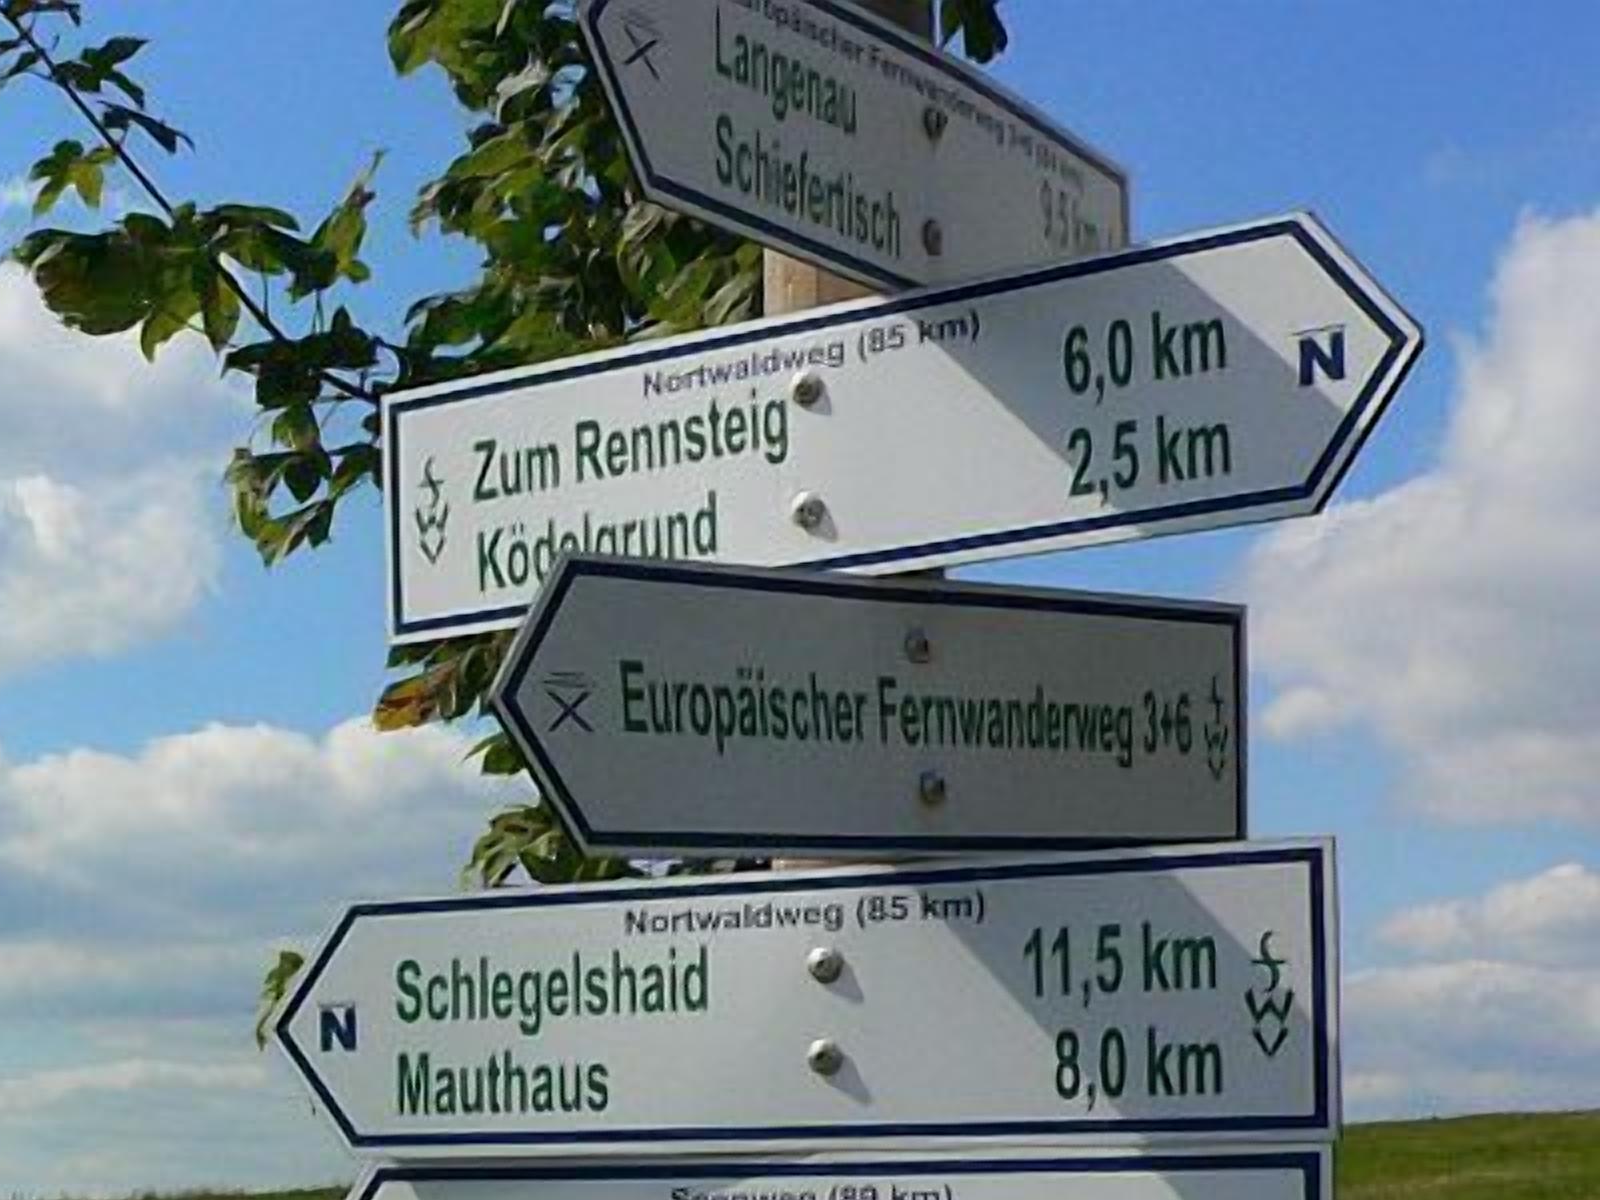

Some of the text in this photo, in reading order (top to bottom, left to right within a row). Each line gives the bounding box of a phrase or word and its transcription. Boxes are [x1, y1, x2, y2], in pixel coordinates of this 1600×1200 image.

[715, 4, 857, 136] Langenau
[715, 113, 901, 258] Schiefertisch
[643, 340, 845, 398] Nortwaldweg
[918, 309, 981, 349] km)
[1299, 328, 1346, 386] N
[473, 310, 1228, 499] Zum Rennsteig 6,0 km
[1068, 419, 1138, 508] 2,5
[1156, 413, 1231, 483] km
[621, 660, 1194, 769] Europäischer Fernwanderweg 3+6
[625, 889, 985, 936] Nortwaldweg (85 km)
[395, 921, 1217, 1036] Schlegelshaid 11,5 km
[320, 1006, 357, 1051] N
[397, 1025, 1224, 1117] Mauthaus 8,0 km
